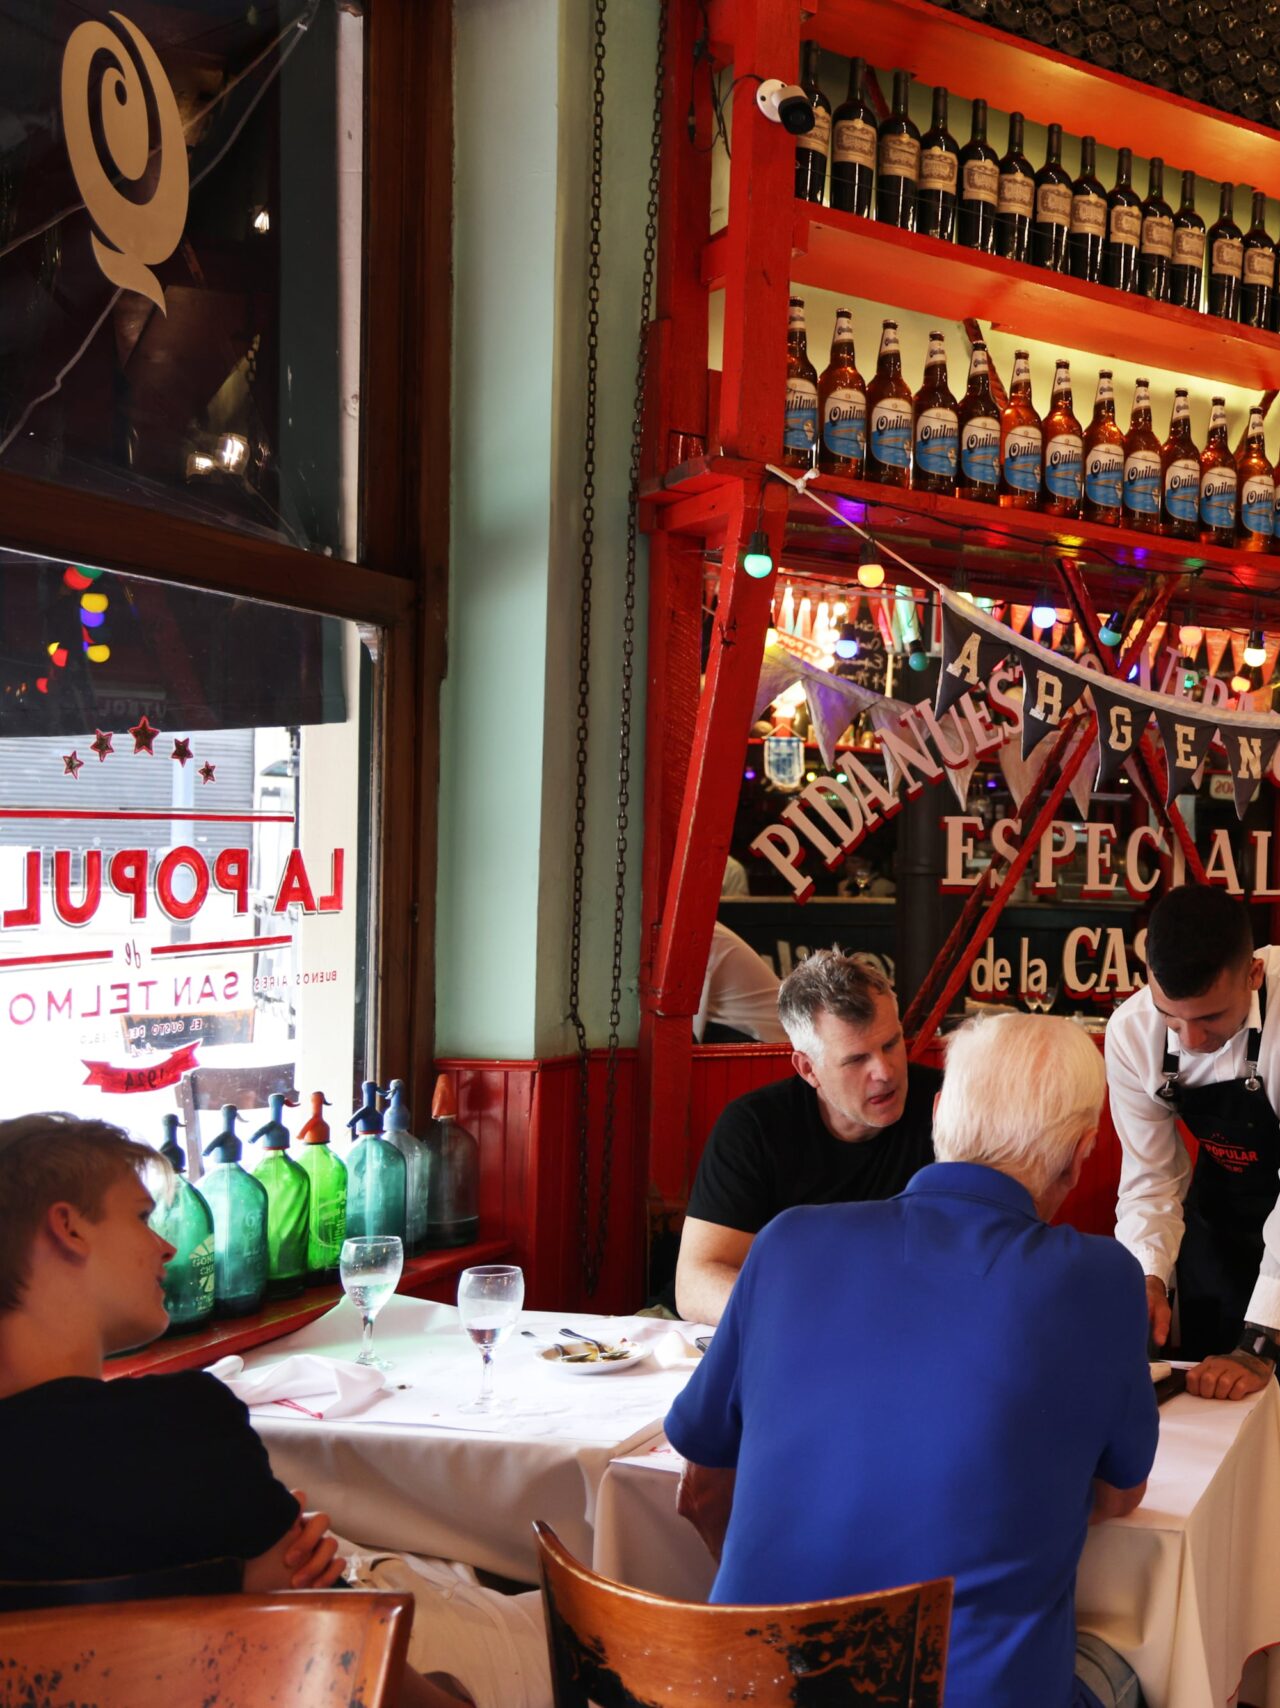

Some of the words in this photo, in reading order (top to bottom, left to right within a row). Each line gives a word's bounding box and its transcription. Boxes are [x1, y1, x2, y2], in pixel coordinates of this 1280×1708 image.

[750, 751, 903, 905] PIDA
[970, 937, 1012, 999] de
[1018, 937, 1048, 998] la
[1204, 1144, 1259, 1162] POPULAR
